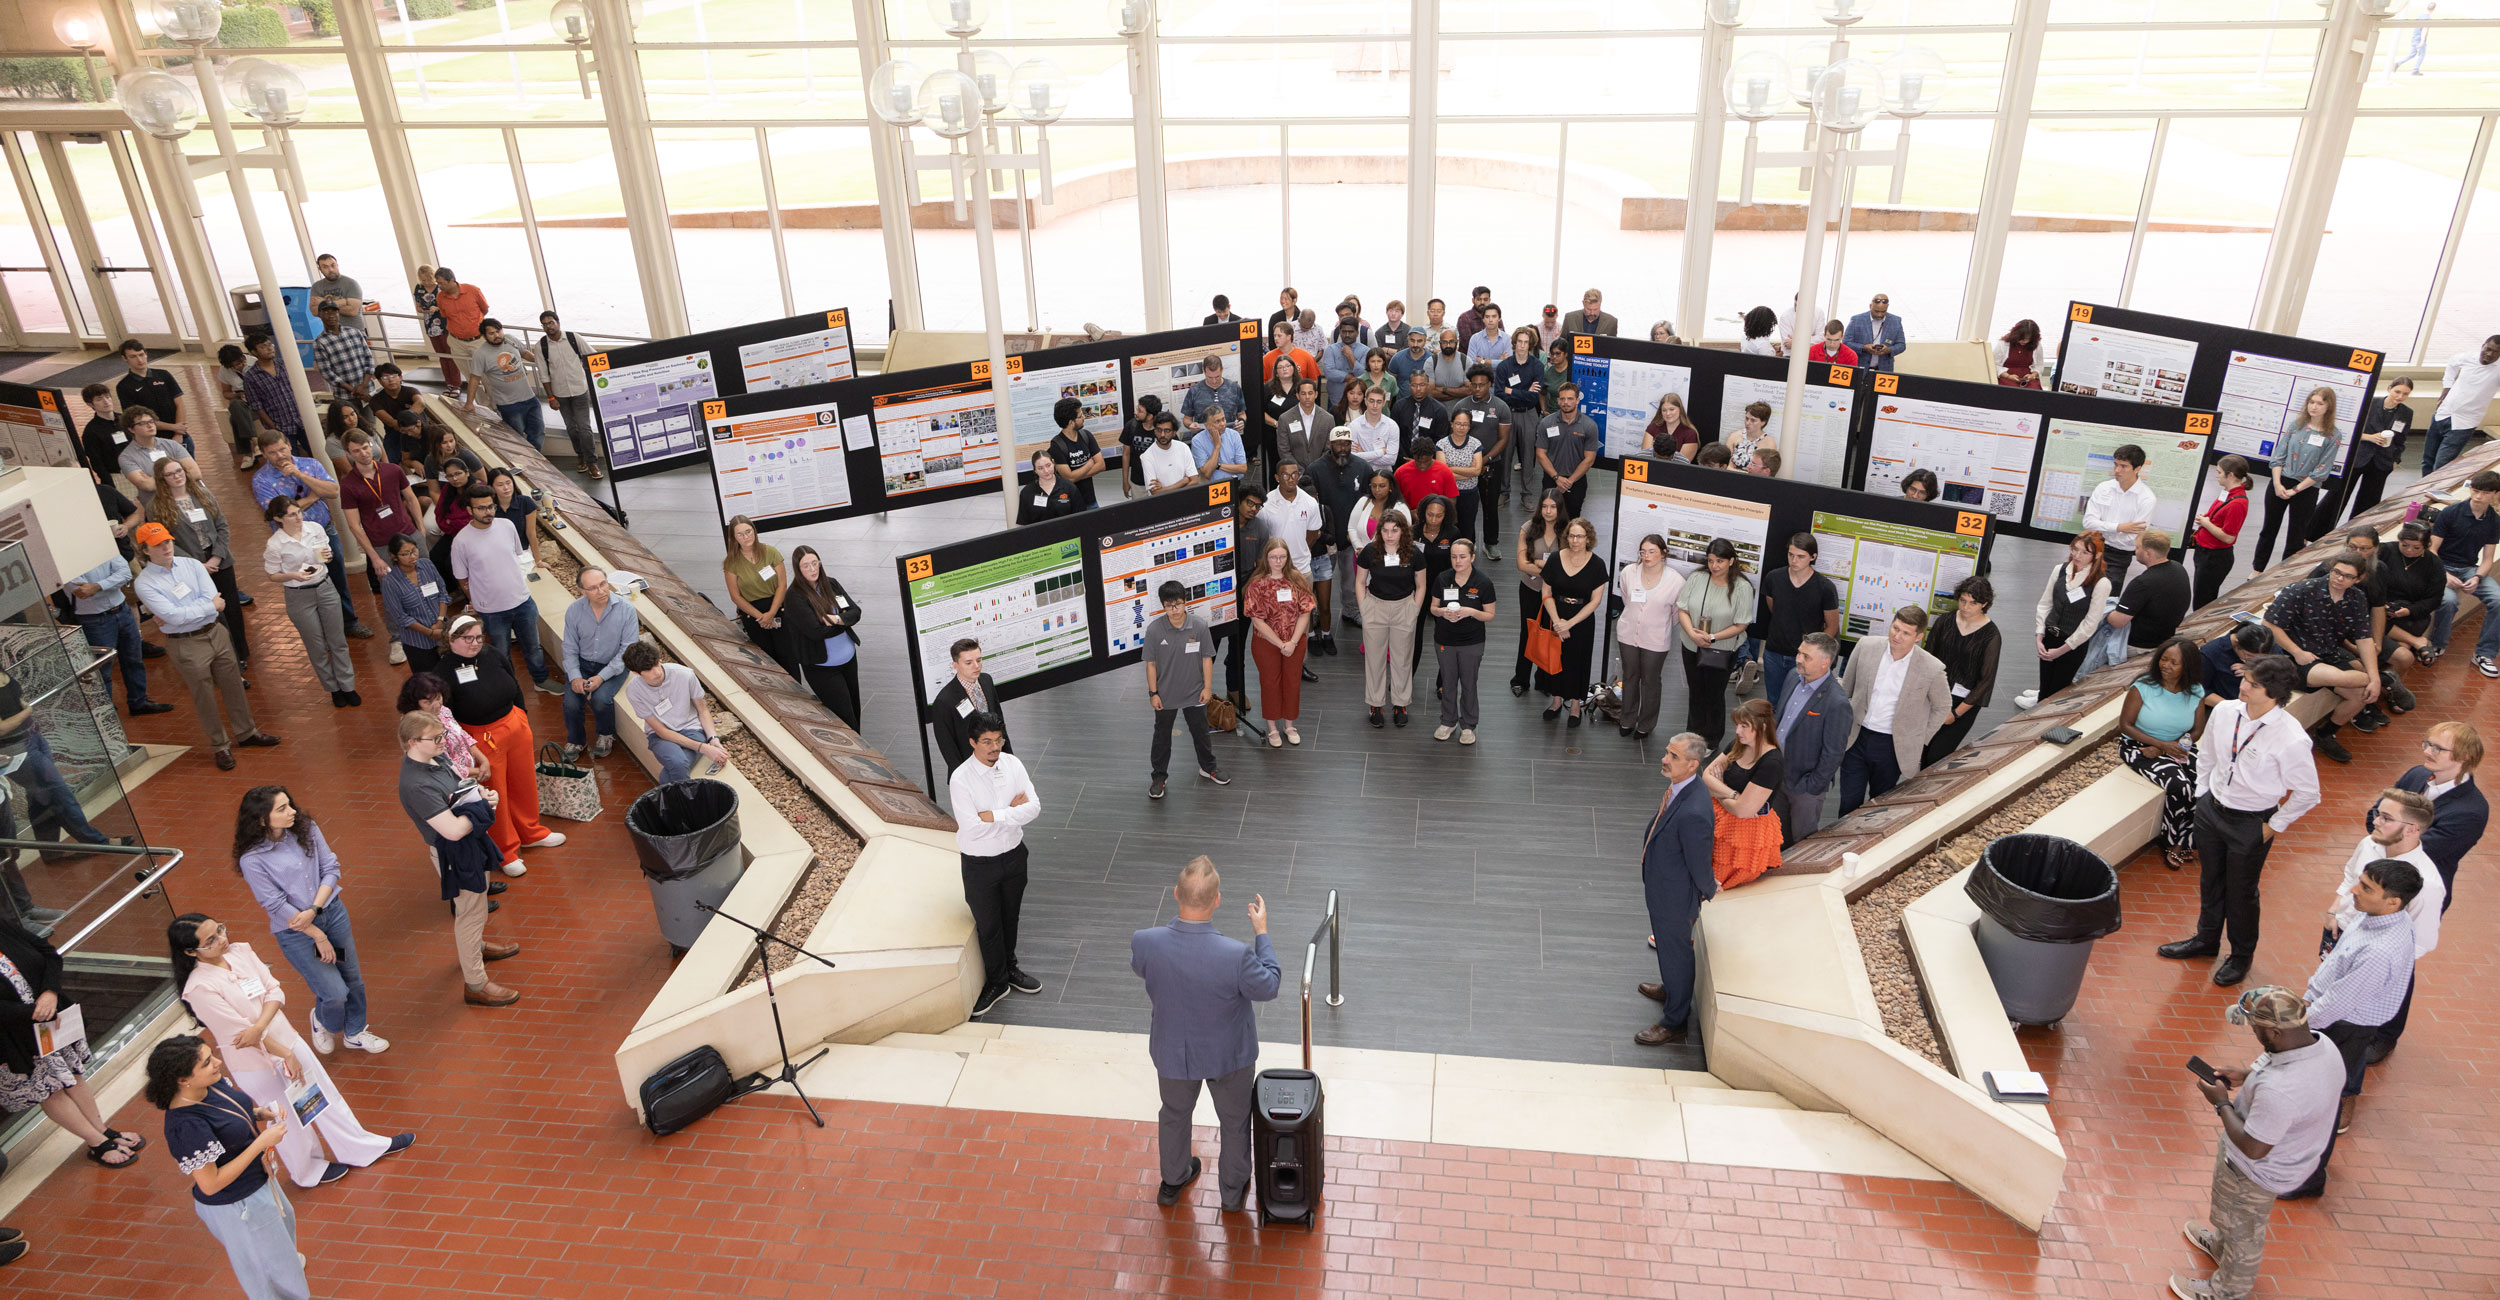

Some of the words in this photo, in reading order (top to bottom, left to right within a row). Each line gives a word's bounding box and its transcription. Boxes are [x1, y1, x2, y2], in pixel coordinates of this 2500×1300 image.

[2074, 307, 2089, 317] 19
[830, 314, 843, 323] 46
[1242, 324, 1256, 334] 40
[1576, 340, 1591, 349] 25
[591, 357, 606, 367] 45
[1007, 358, 1020, 369] 39
[2353, 353, 2372, 366] 20
[974, 364, 989, 374] 38
[1833, 370, 1849, 381] 26
[1878, 378, 1895, 388] 27
[42, 396, 54, 406] 64
[706, 405, 722, 414] 37
[2189, 417, 2209, 428] 28
[1627, 464, 1644, 476] 31
[1211, 486, 1228, 499] 34
[1960, 517, 1982, 529] 32
[1060, 543, 1079, 552] USDA
[910, 559, 929, 574] 33
